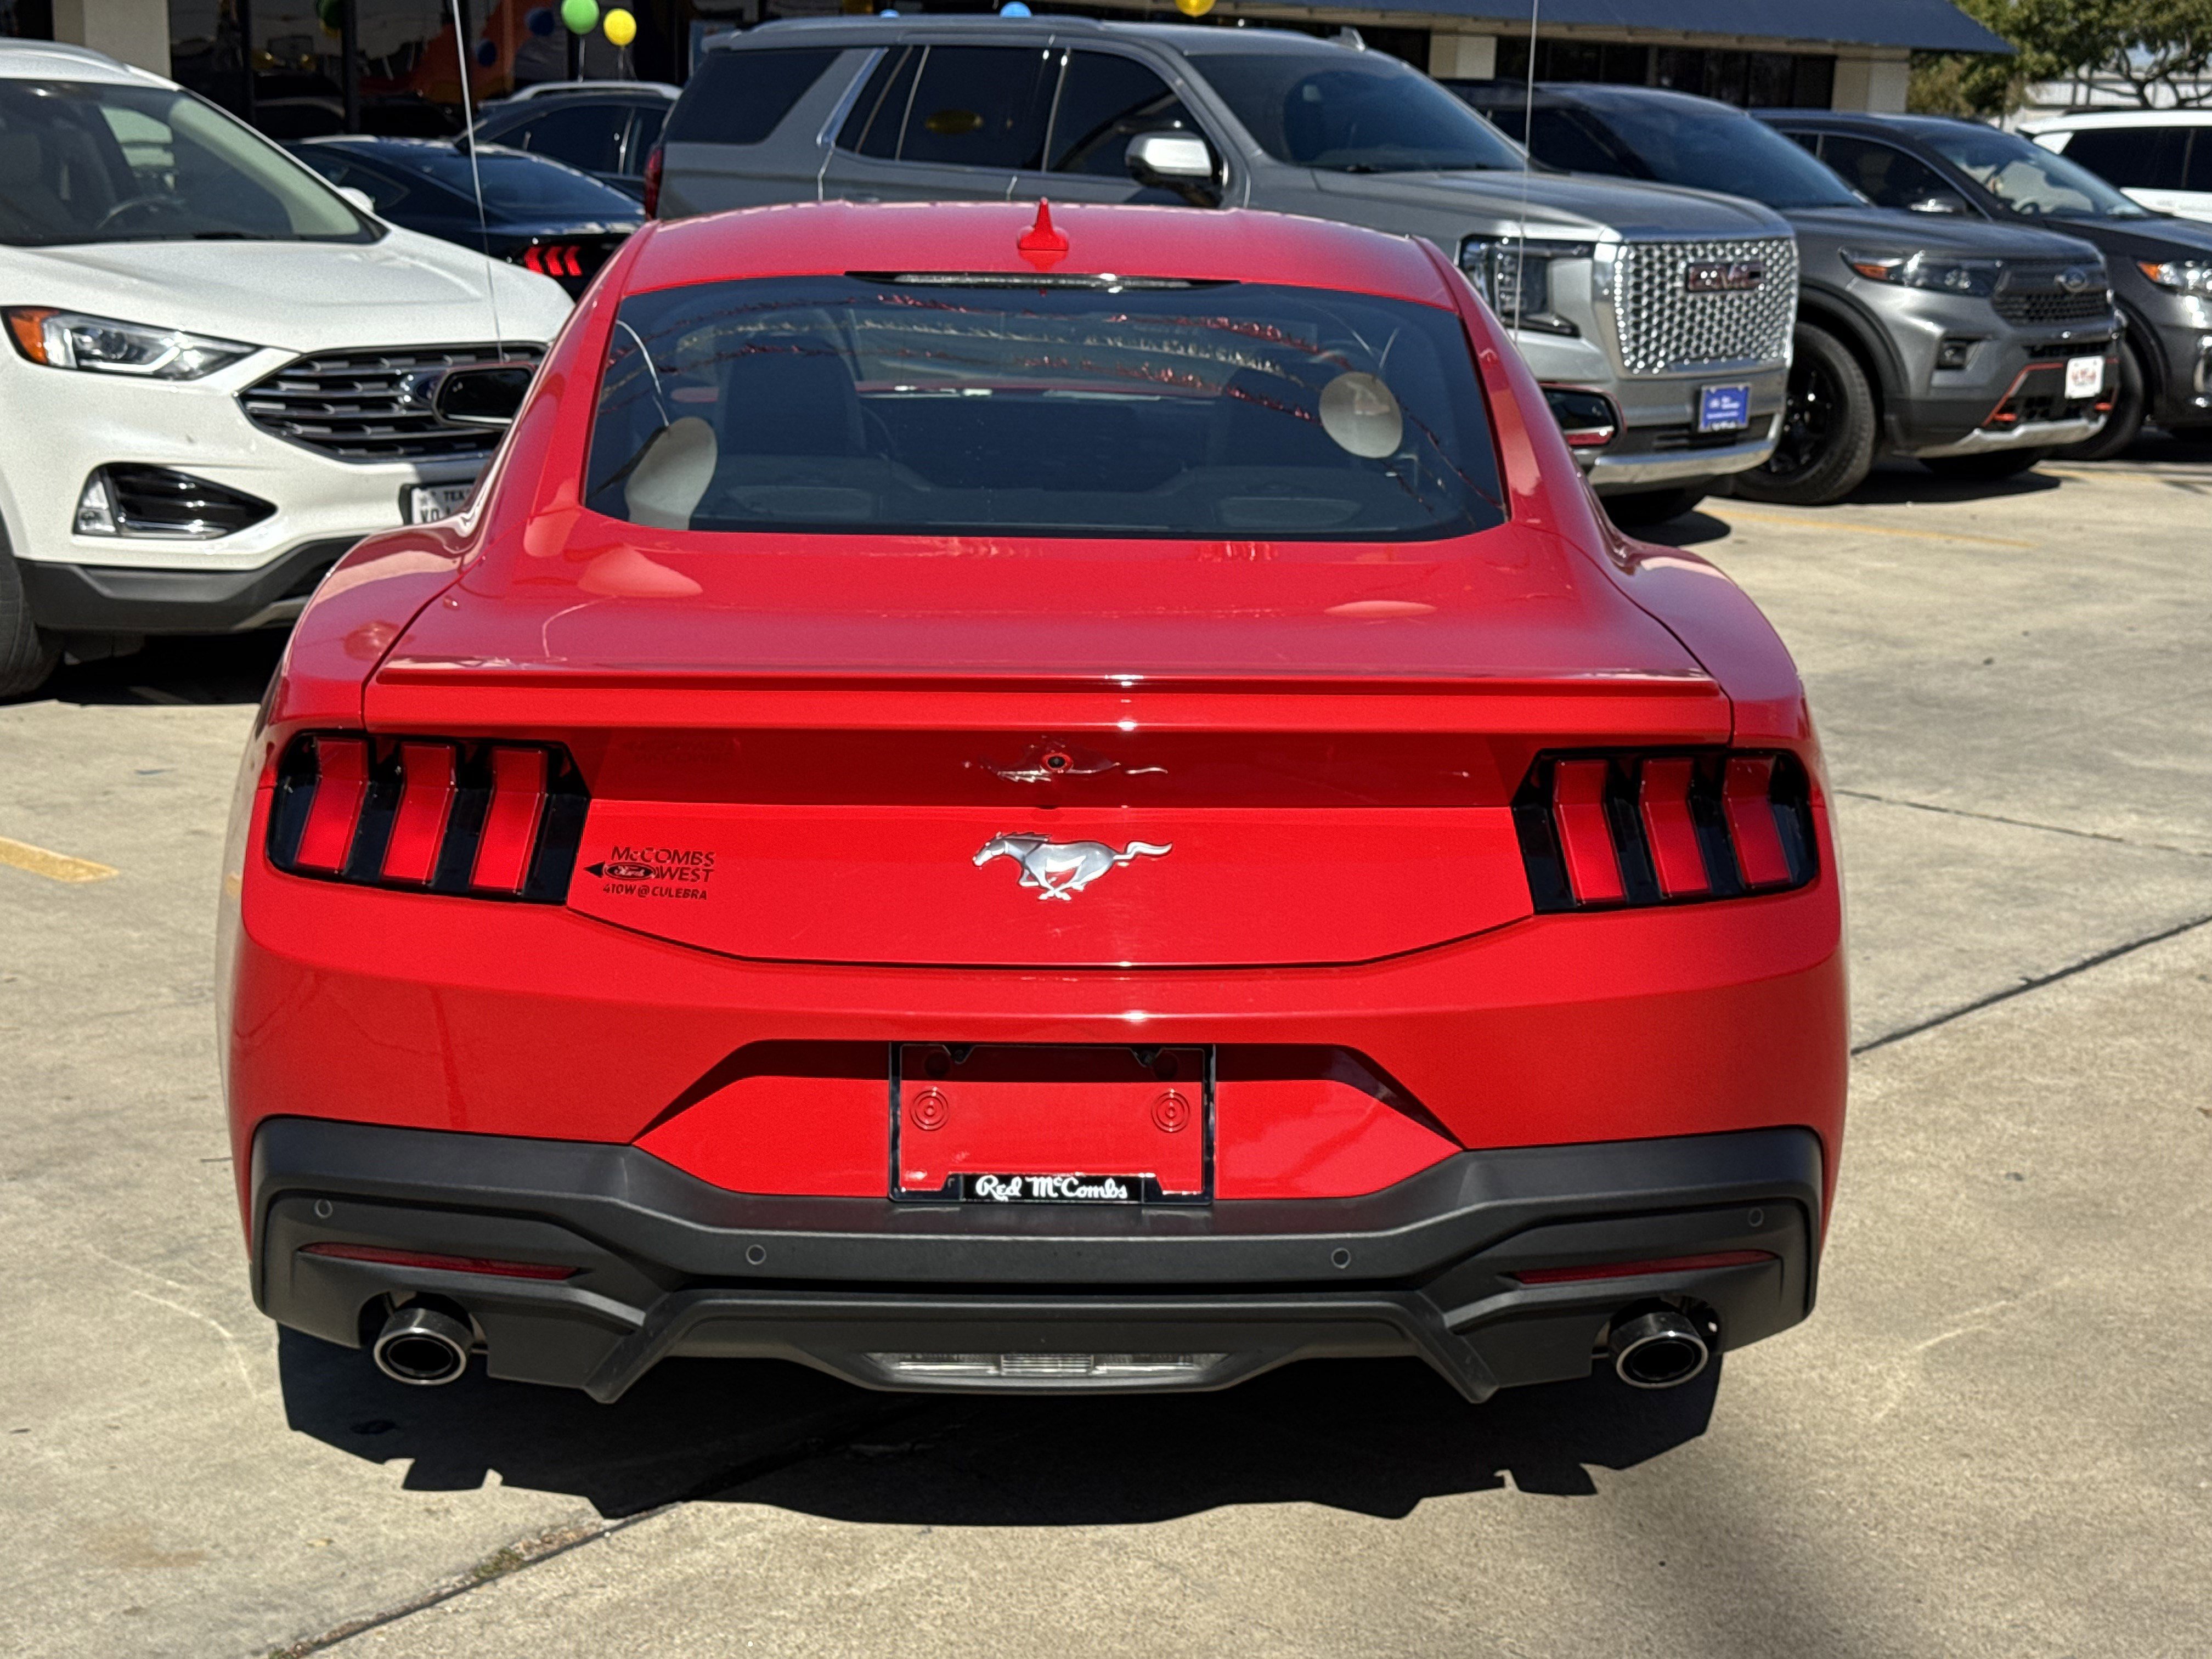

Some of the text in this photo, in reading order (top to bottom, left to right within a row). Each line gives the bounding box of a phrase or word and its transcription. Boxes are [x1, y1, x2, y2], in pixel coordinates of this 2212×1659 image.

[658, 865, 713, 882] WEST
[975, 1174, 1128, 1201] Red McCombs
